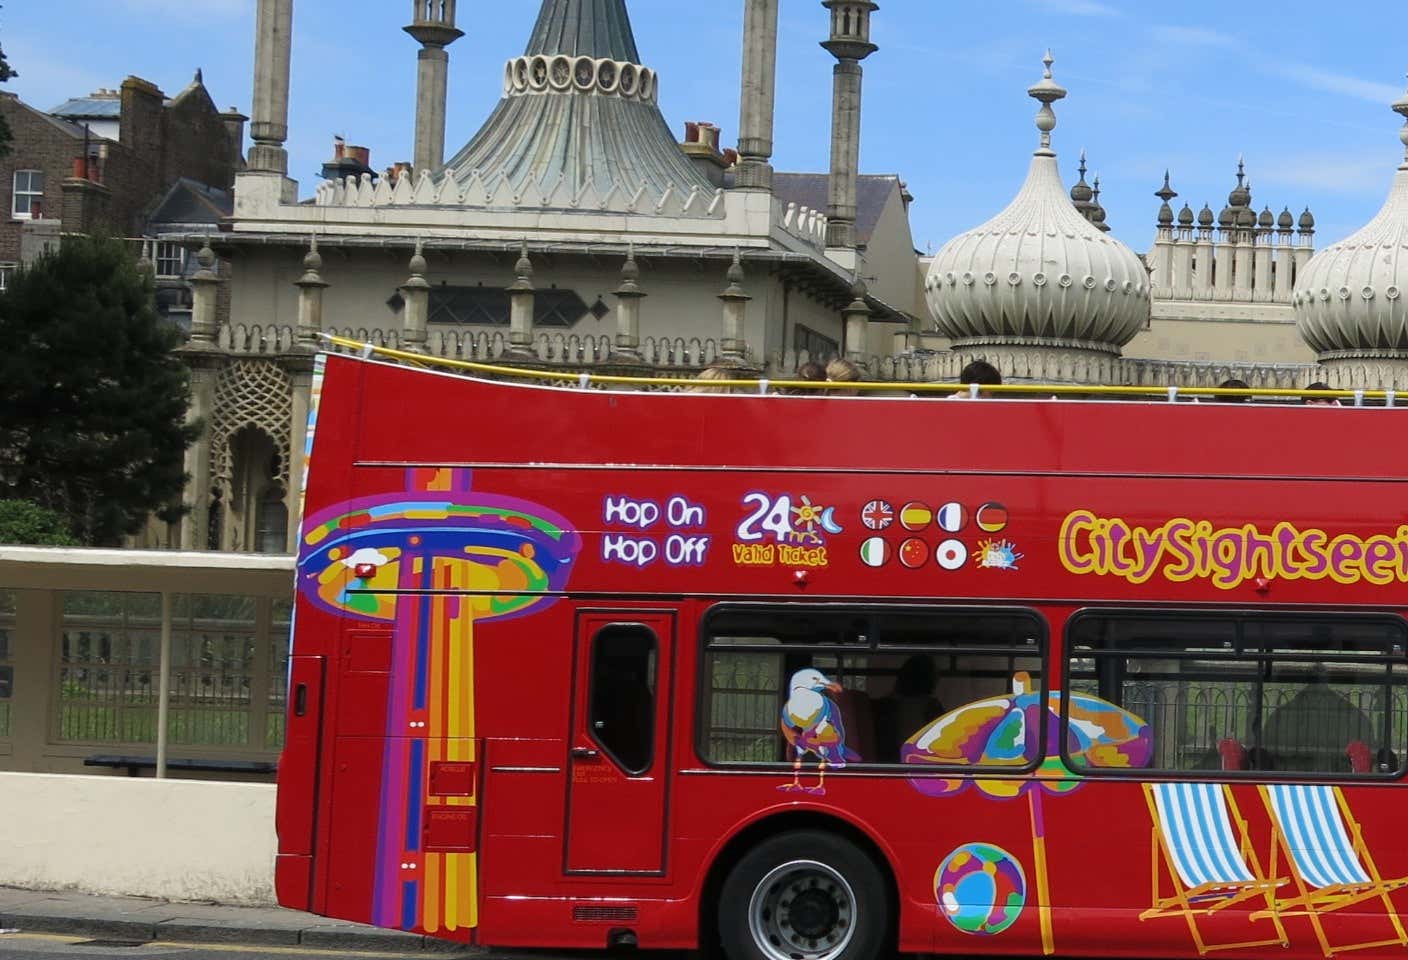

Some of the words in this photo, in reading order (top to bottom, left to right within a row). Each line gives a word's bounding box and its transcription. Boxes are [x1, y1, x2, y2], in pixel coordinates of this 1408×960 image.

[604, 496, 660, 530] Hop
[667, 496, 704, 526] On
[738, 492, 793, 541] 24
[603, 534, 657, 567] Hop
[665, 533, 709, 564] Off
[733, 544, 775, 564] Valid
[777, 544, 828, 566] Ticket
